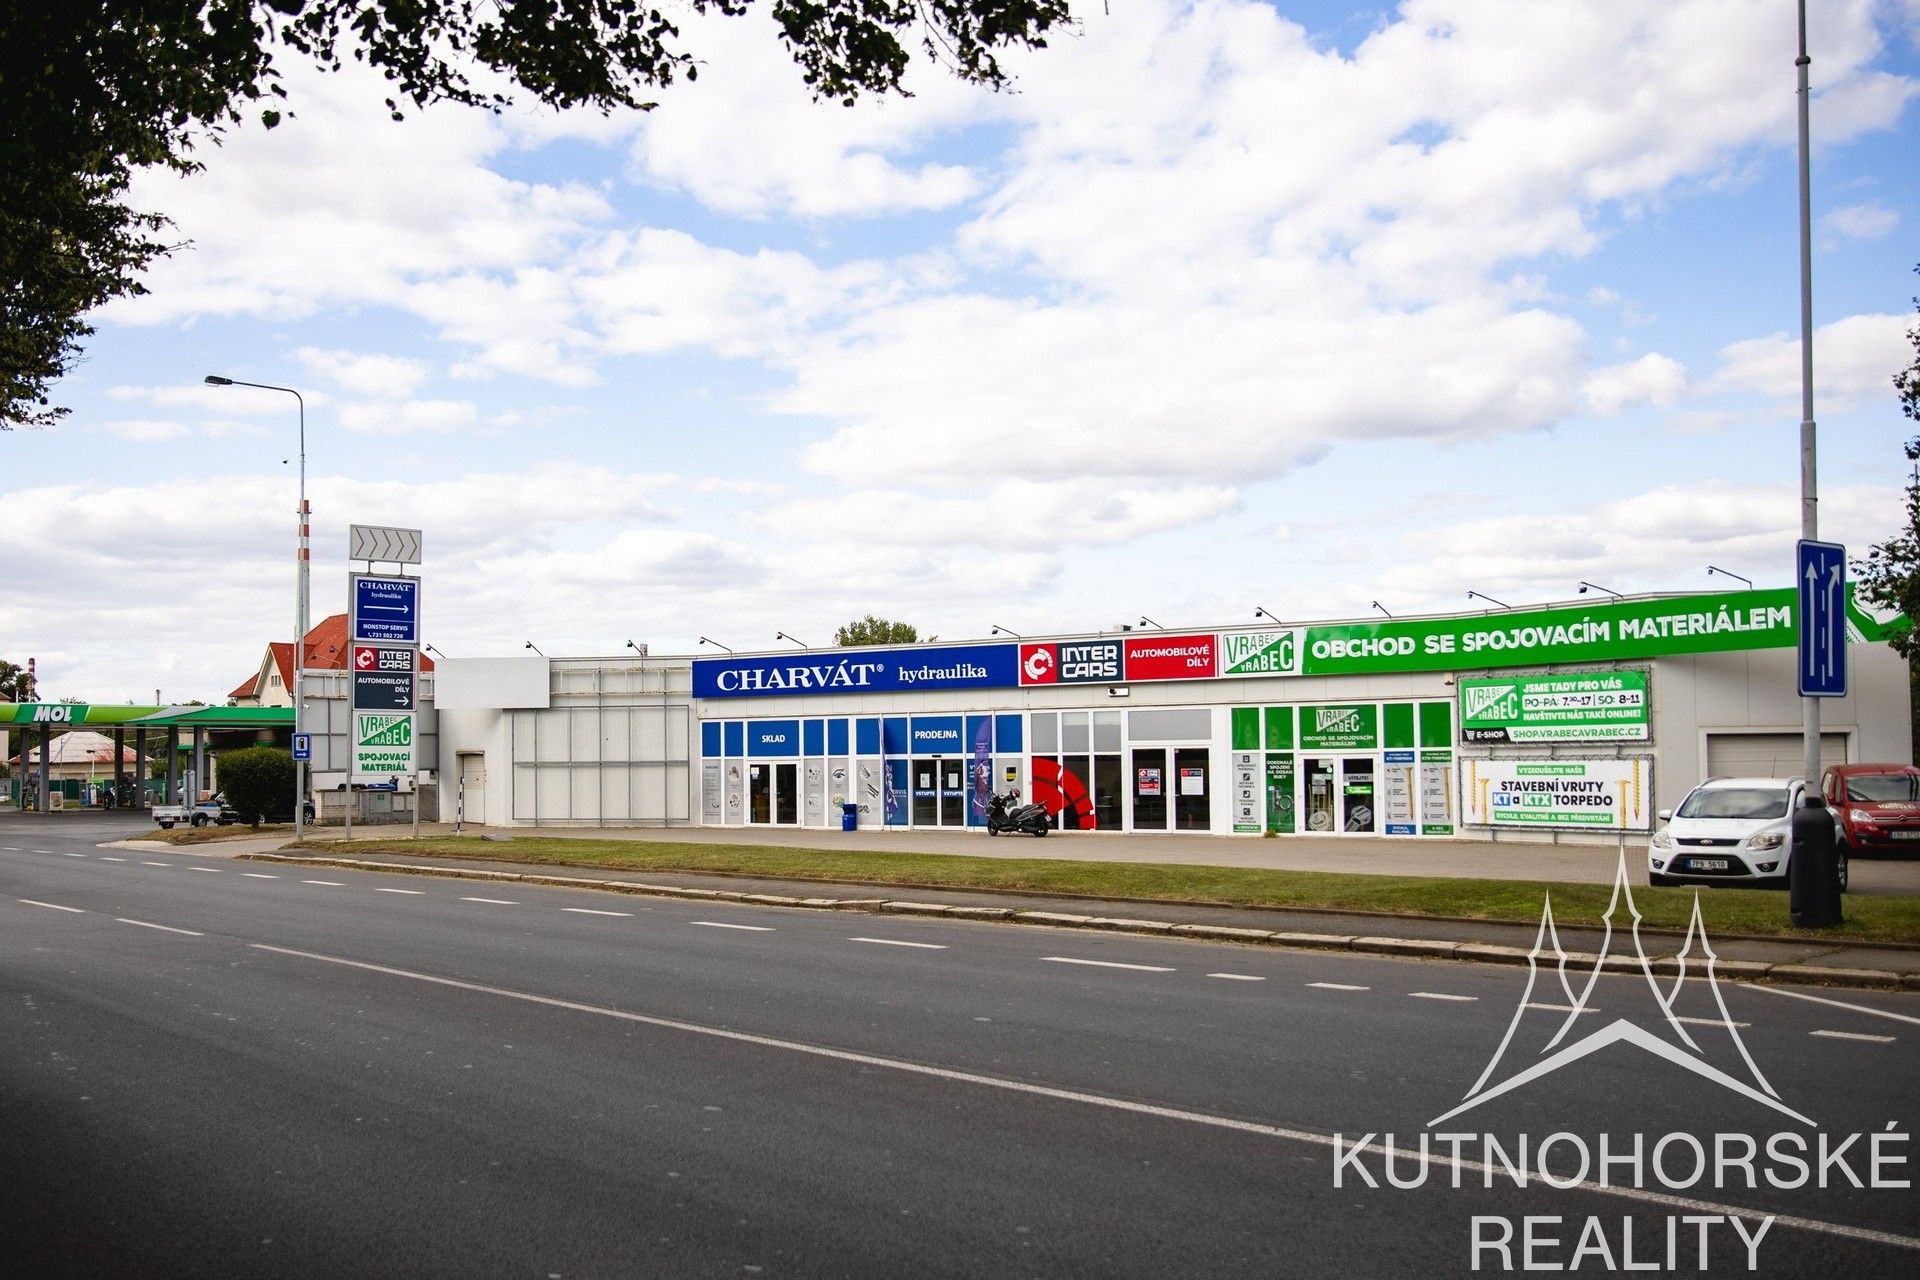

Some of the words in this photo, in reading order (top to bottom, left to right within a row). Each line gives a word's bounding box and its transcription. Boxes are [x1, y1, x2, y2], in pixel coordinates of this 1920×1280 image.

[371, 592, 401, 600] hydraulika
[363, 623, 389, 631] NONSTOP
[390, 624, 409, 632] SERVIS
[1311, 636, 1415, 660] OBCHOD
[1424, 634, 1455, 654] SE
[1462, 617, 1609, 653] SPOJOVACÍM
[1619, 604, 1791, 641] MATERIÁLEM
[379, 651, 410, 660] INTER
[1062, 645, 1117, 662] INTER
[1130, 644, 1210, 658] AUTOMOBILOVÉ
[1225, 634, 1275, 664] VRABEC
[1186, 656, 1210, 668] DÍLY
[1240, 640, 1293, 672] VRABEC
[379, 660, 410, 669] CARS
[1062, 662, 1117, 678] CARS
[899, 663, 988, 683] hydraulika
[358, 677, 410, 685] AUTOMOBILOVÉ
[1523, 683, 1549, 693] JSME
[1550, 682, 1576, 692] TADY
[1577, 681, 1601, 691] PRO
[1601, 677, 1623, 690] VÁS
[1619, 694, 1640, 704] 8-11
[1478, 693, 1518, 720] VRABEC
[33, 705, 72, 722] MOL
[1523, 711, 1567, 721] NAVŠTIVTE
[1567, 710, 1584, 720] NÁS
[1585, 709, 1607, 719] TAKÉ
[1607, 709, 1641, 718] ONLINE!
[360, 716, 398, 738] VRABEC
[1326, 714, 1359, 733] VRABEC
[370, 722, 410, 744] VRABEC
[761, 734, 786, 744] SKLAD
[914, 730, 958, 740] PRODEJNA
[1476, 731, 1504, 739] E-SHOP
[1513, 728, 1641, 738] SHOP.VRABECAVRABEC.CZ
[358, 751, 411, 761] SPOJOVACÍ
[361, 762, 407, 771] MATERIÁL
[1518, 766, 1564, 775] VYZKOUŠEJTE
[1565, 766, 1583, 775] NAŠE
[1501, 778, 1559, 793] STAVEBNÍ
[1561, 781, 1604, 792] VRUTY
[1493, 793, 1510, 805] KT
[1524, 794, 1551, 806] KTX
[1554, 795, 1613, 806] TORPEDO
